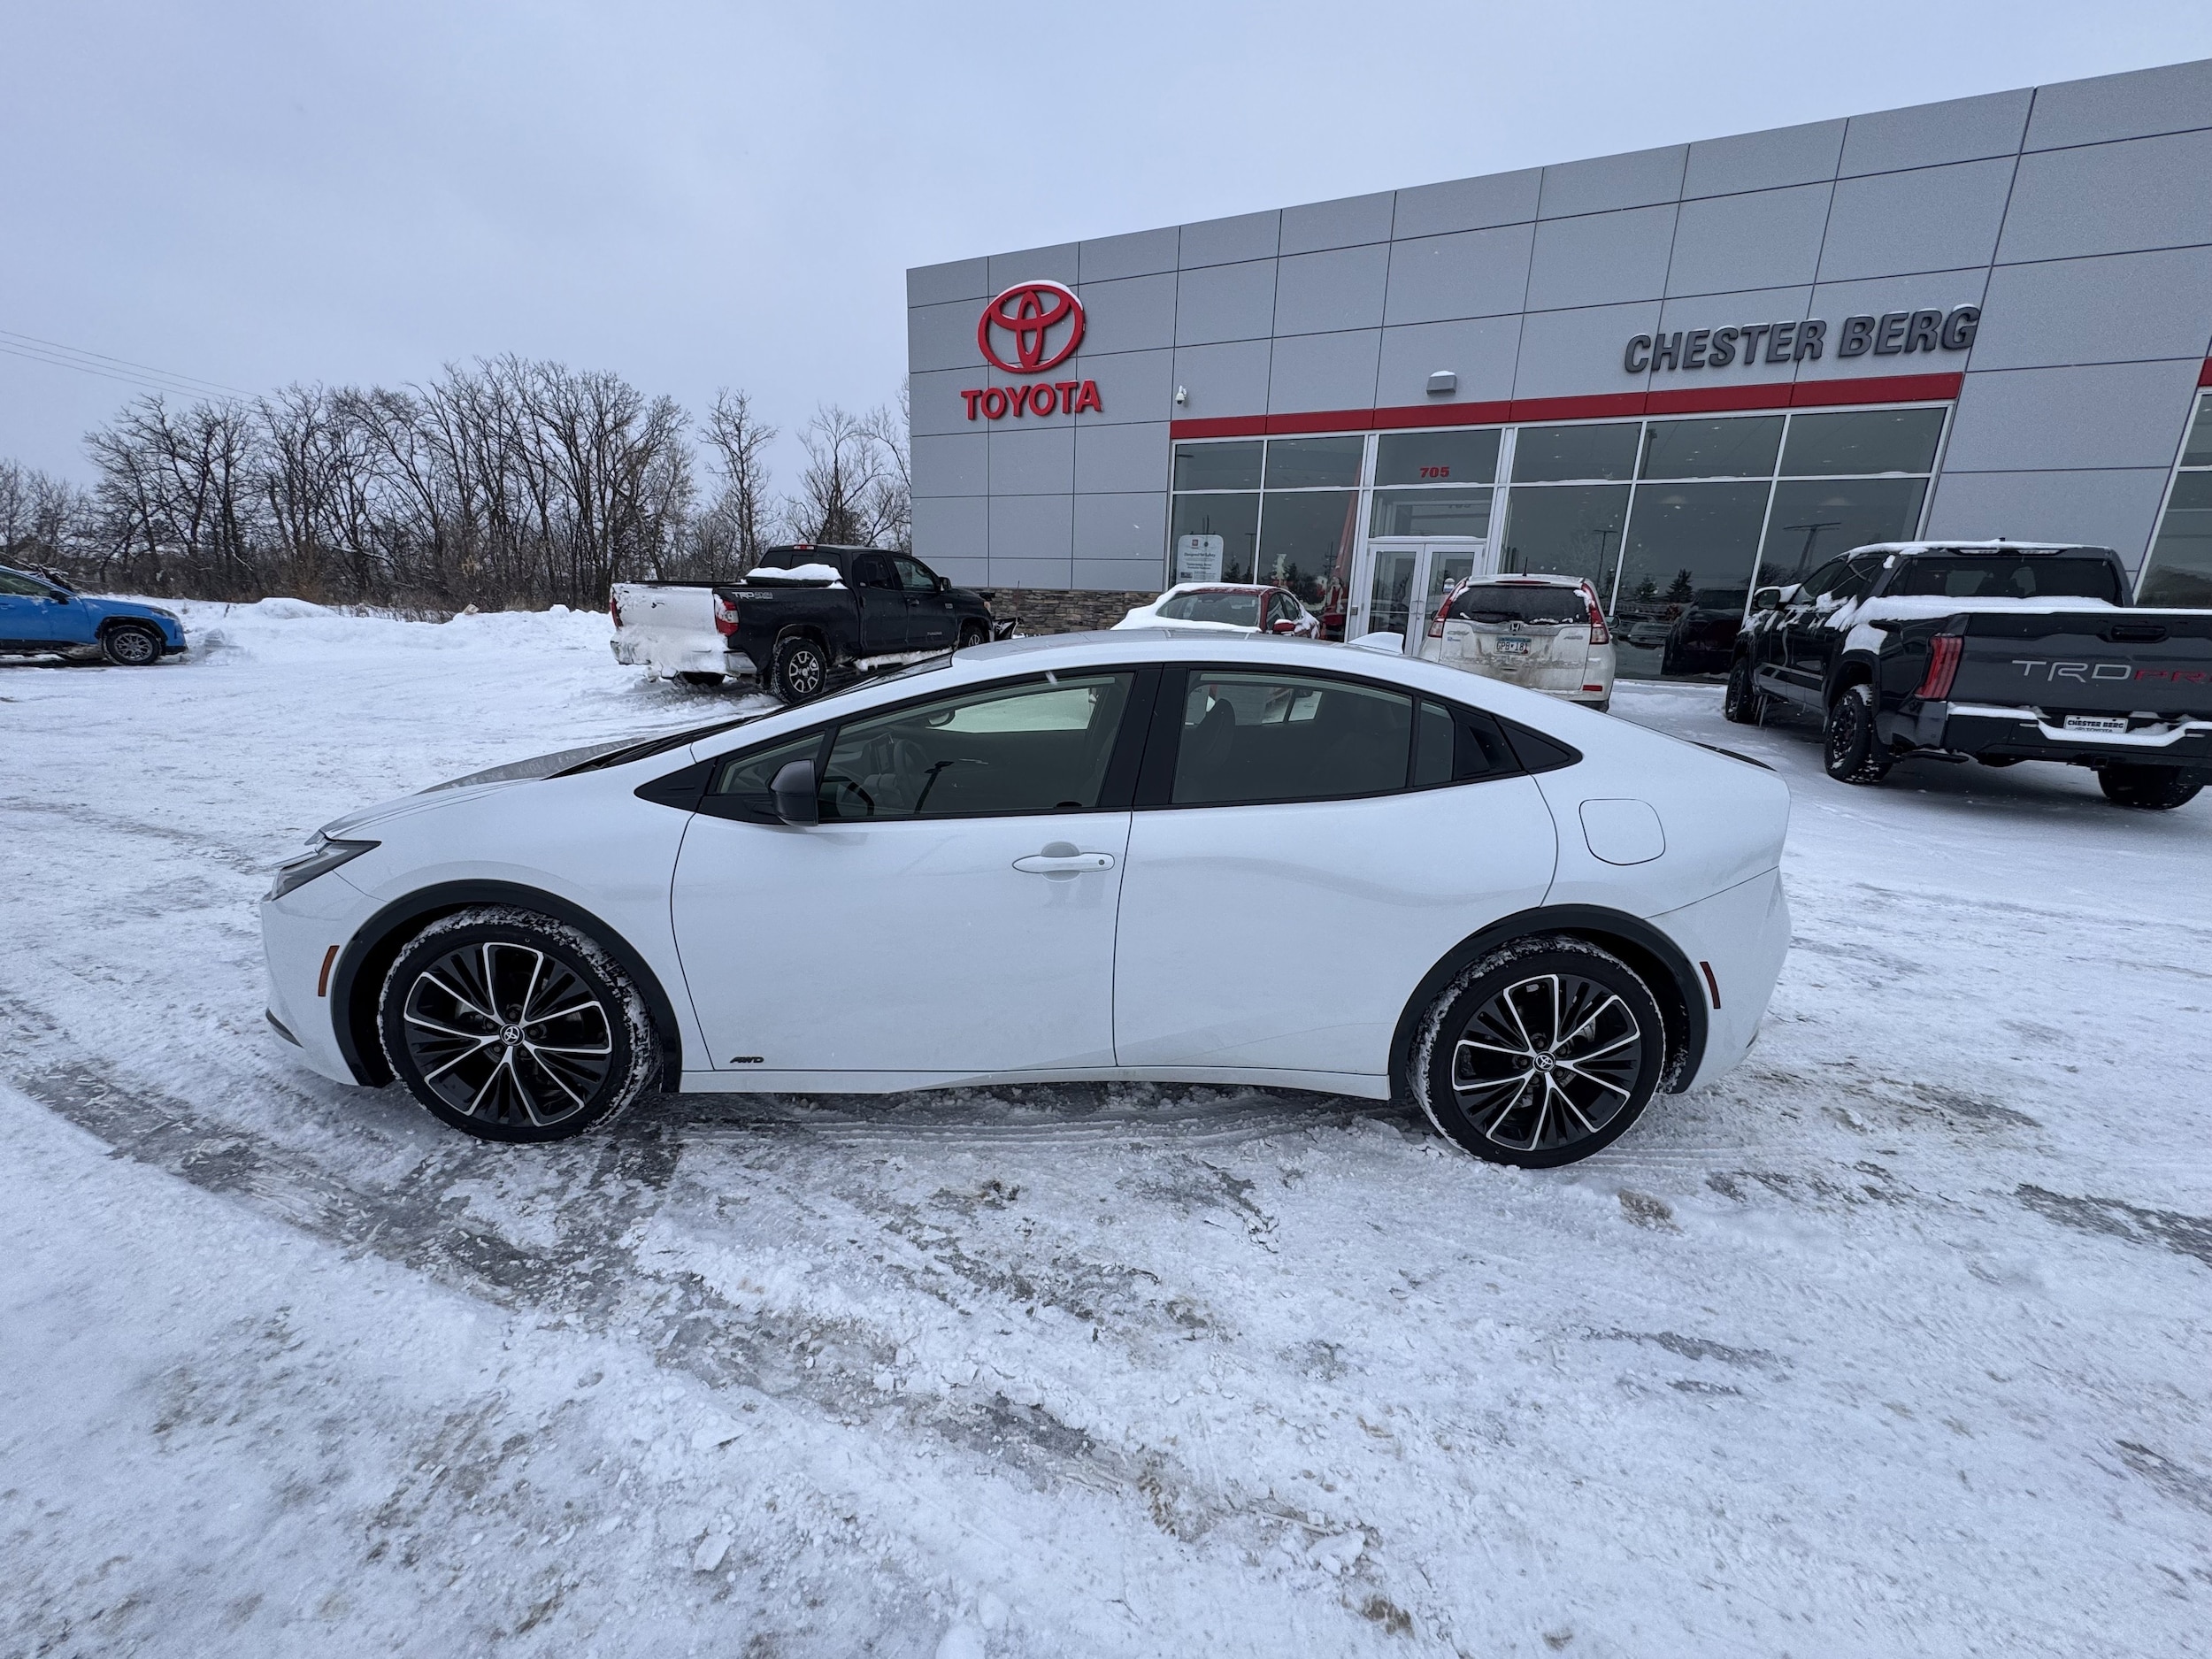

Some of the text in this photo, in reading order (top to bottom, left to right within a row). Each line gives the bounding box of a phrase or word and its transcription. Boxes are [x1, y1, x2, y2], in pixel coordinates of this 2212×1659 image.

[1624, 306, 1981, 373] CHESTER BERG
[961, 380, 1102, 420] TOYOTA
[1420, 466, 1450, 478] 705
[2012, 660, 2212, 683] TRD PR
